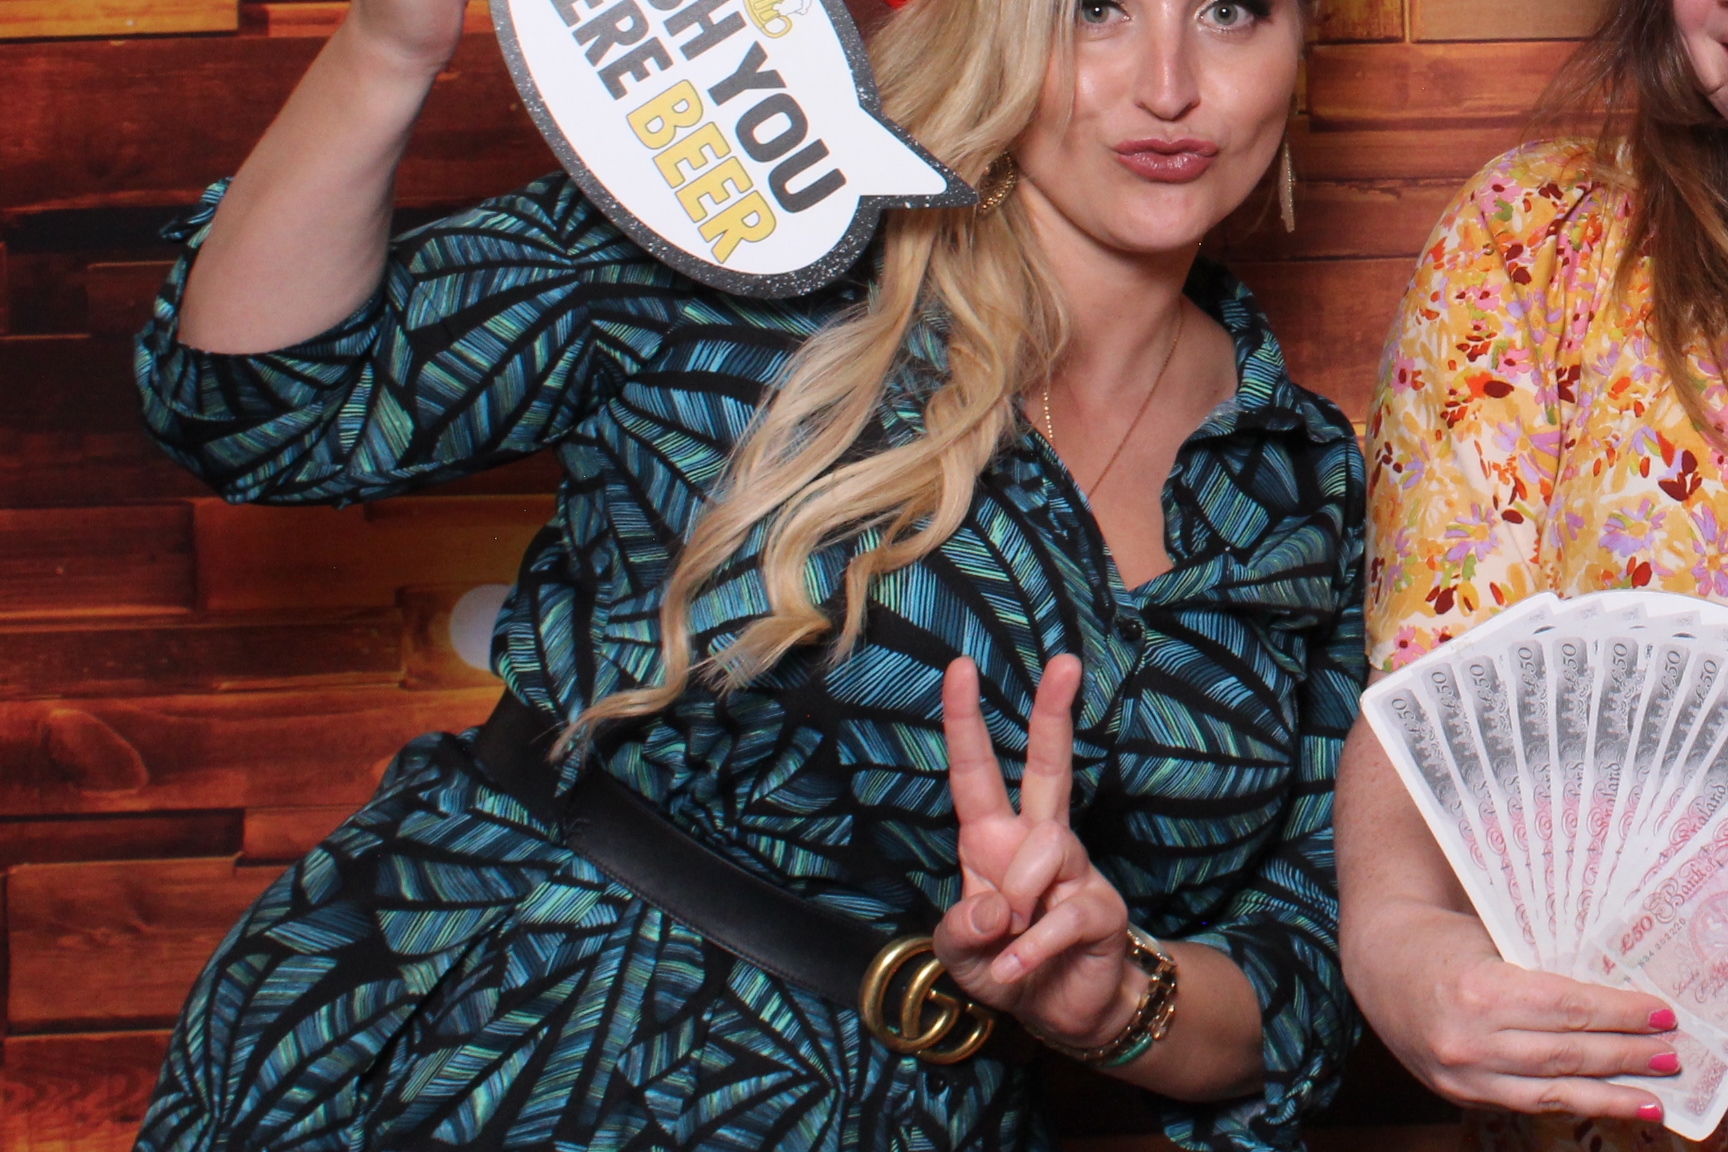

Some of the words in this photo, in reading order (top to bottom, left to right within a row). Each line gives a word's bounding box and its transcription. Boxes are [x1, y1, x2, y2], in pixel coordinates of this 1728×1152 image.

[707, 40, 847, 214] YOU
[626, 78, 777, 265] BEER
[1469, 663, 1494, 705] £50
[1517, 646, 1538, 689] £50
[1561, 642, 1580, 685] £50
[1610, 642, 1628, 686] £50
[1661, 649, 1682, 697] £50
[1695, 659, 1719, 703] £50
[1431, 671, 1457, 709] £50
[1391, 697, 1421, 735] £50
[1643, 856, 1706, 924] Bank
[1621, 914, 1653, 956] £50
